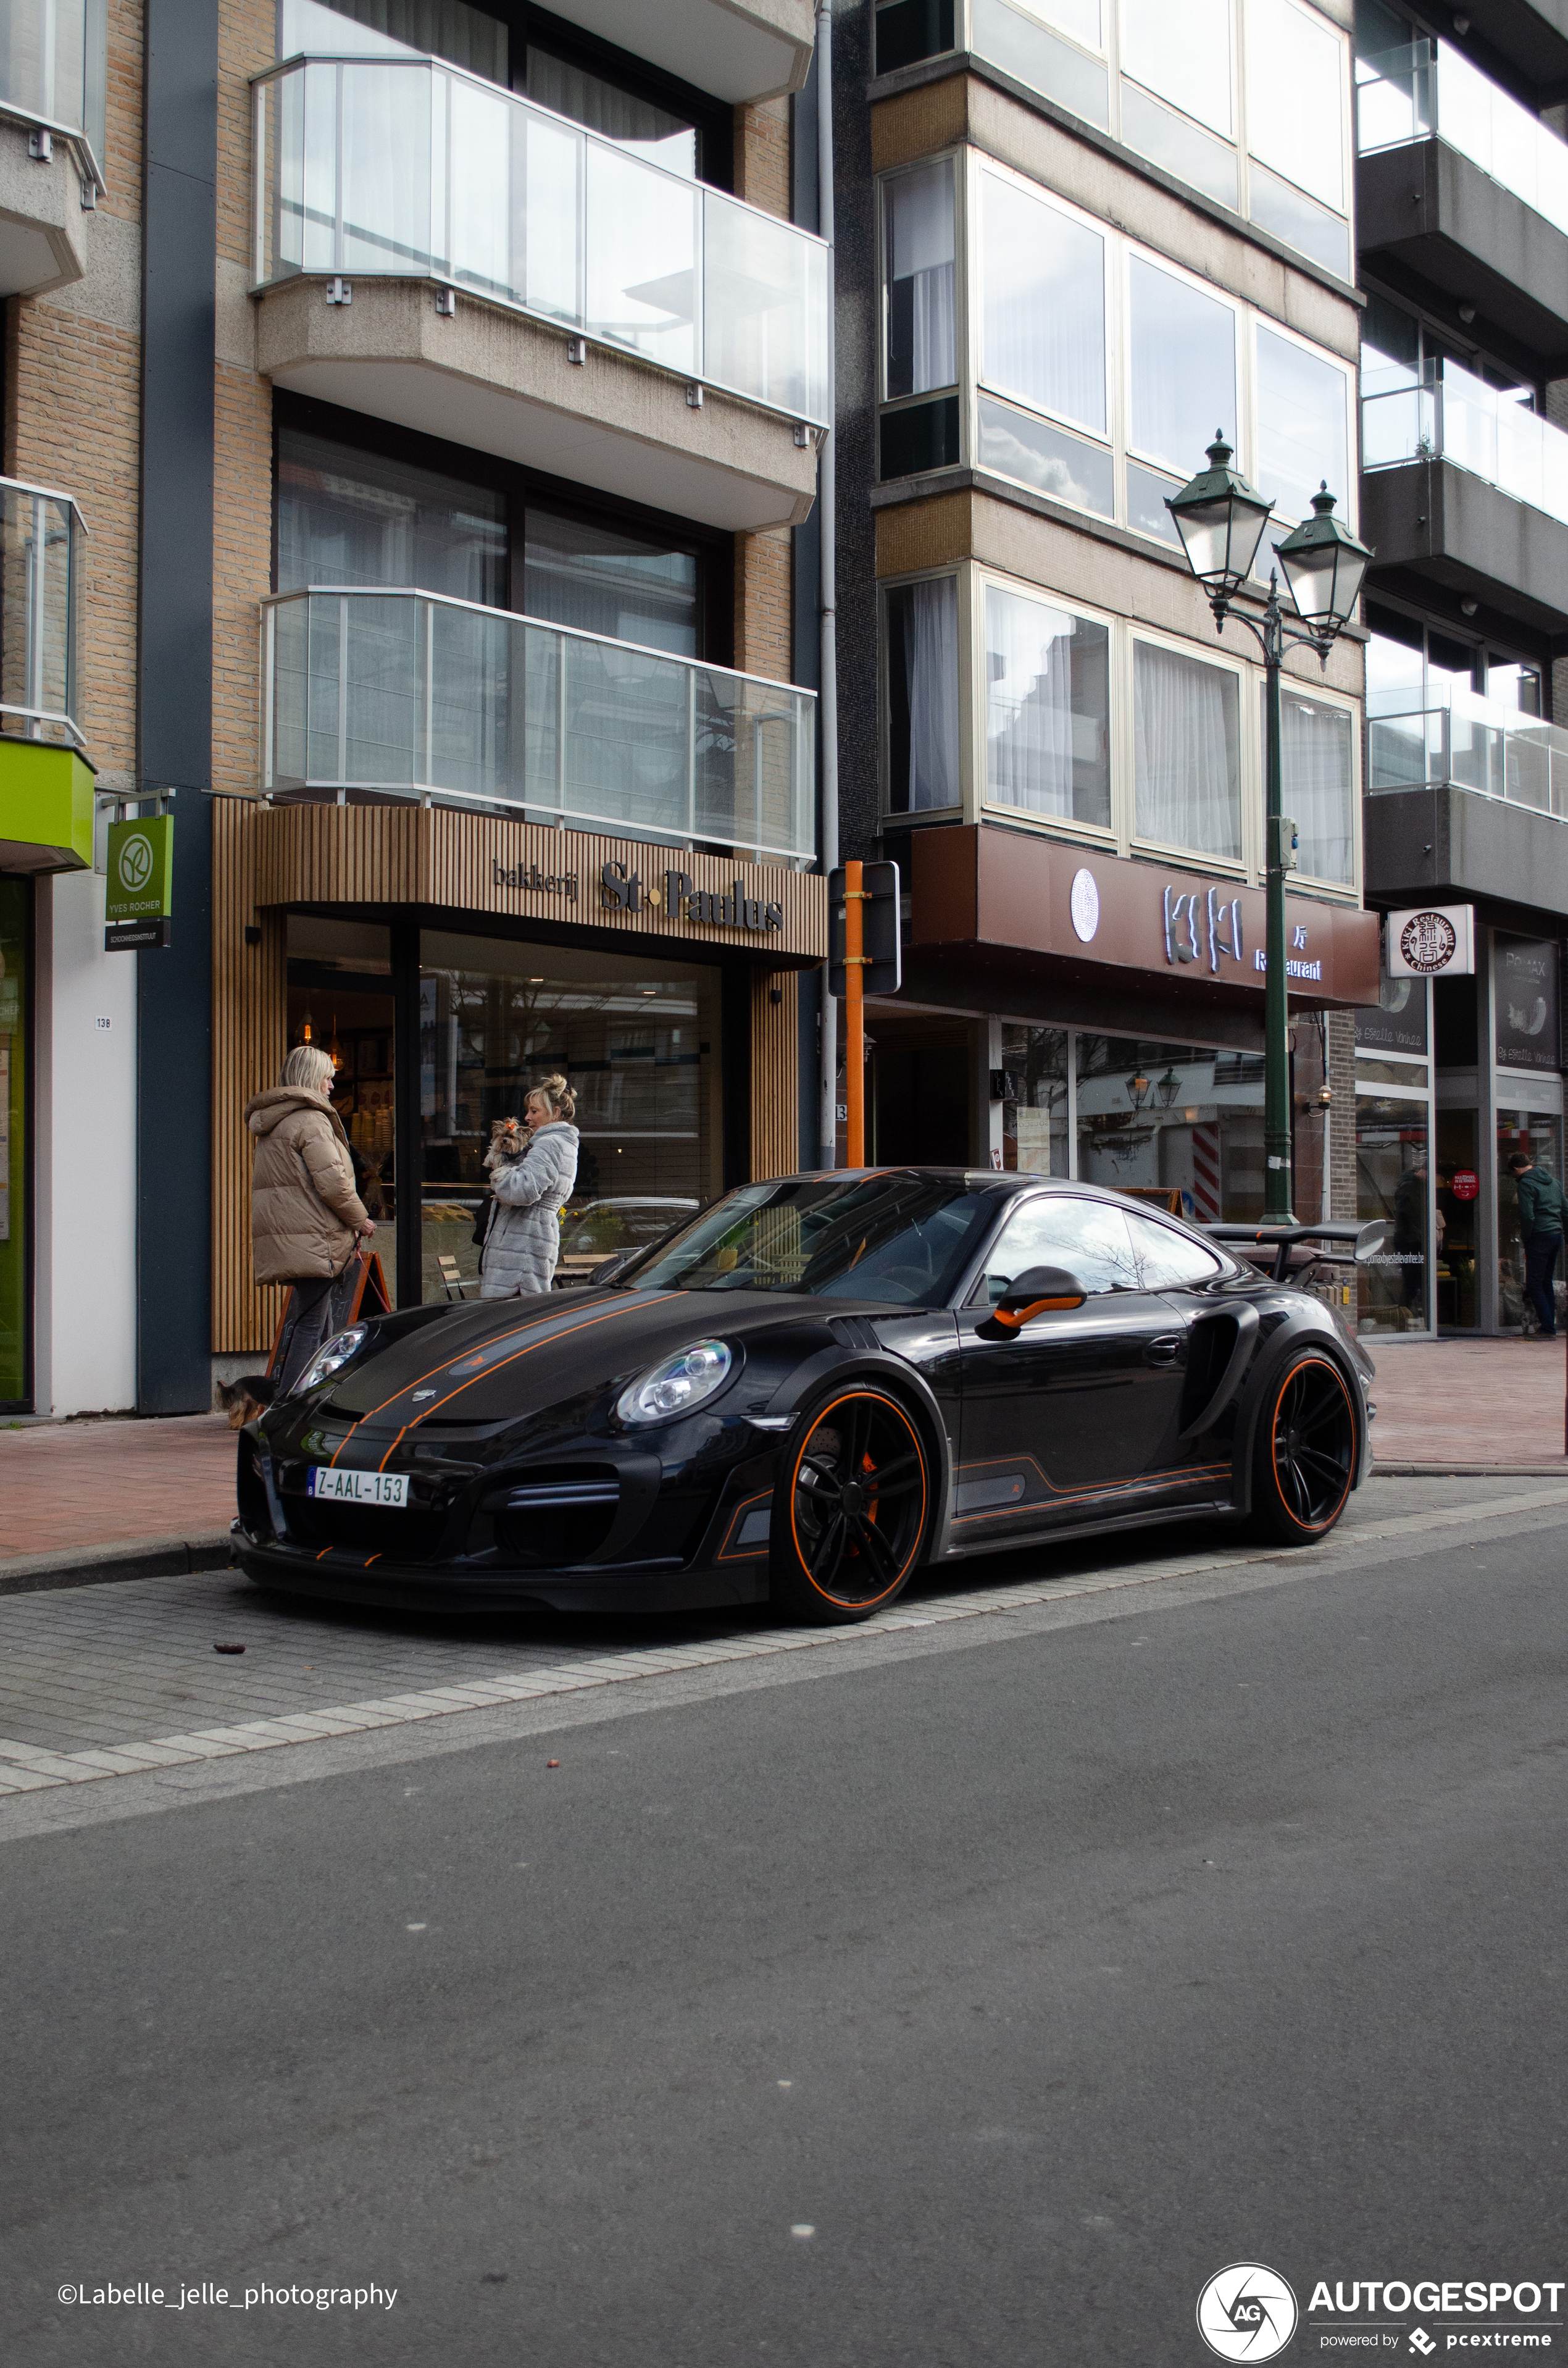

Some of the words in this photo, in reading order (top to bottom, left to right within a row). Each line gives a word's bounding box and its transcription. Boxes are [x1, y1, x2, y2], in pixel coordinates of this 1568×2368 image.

[110, 904, 127, 913] YVES
[130, 900, 161, 911] ROCHER
[493, 858, 579, 903] bakkerij
[664, 869, 783, 933] Paulus
[1412, 914, 1455, 946] Restaurant
[1254, 949, 1322, 981] Raurant
[1410, 958, 1448, 972] Chinese
[97, 1018, 111, 1028] 138
[1005, 1071, 1015, 1097] OPEN
[308, 1486, 314, 1496] B
[319, 1471, 402, 1502] Z-AAL-153
